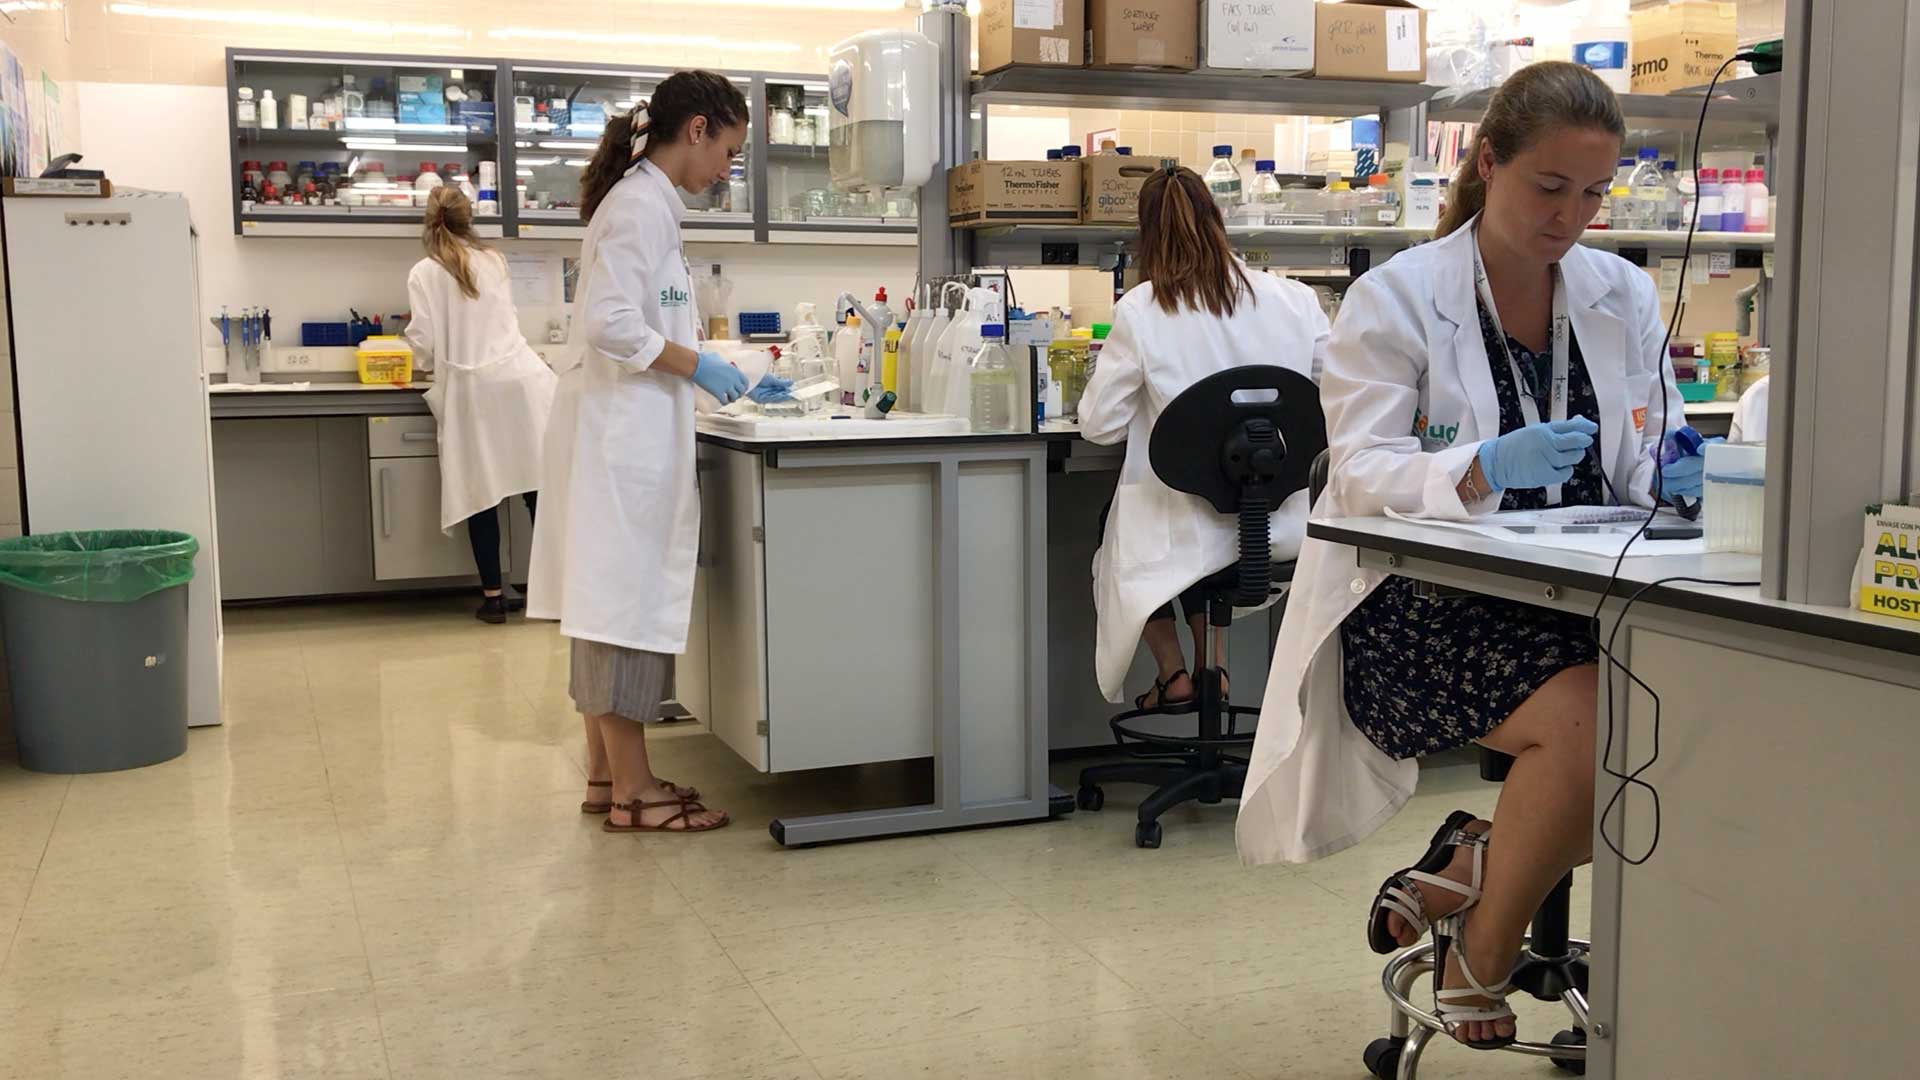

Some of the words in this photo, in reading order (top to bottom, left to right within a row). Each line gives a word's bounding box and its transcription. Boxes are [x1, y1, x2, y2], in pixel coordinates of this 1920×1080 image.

[1695, 51, 1724, 60] Thermo
[1631, 57, 1669, 78] ermo
[1098, 193, 1126, 208] gibco
[1875, 532, 1920, 560] AL
[1874, 560, 1920, 590] PR
